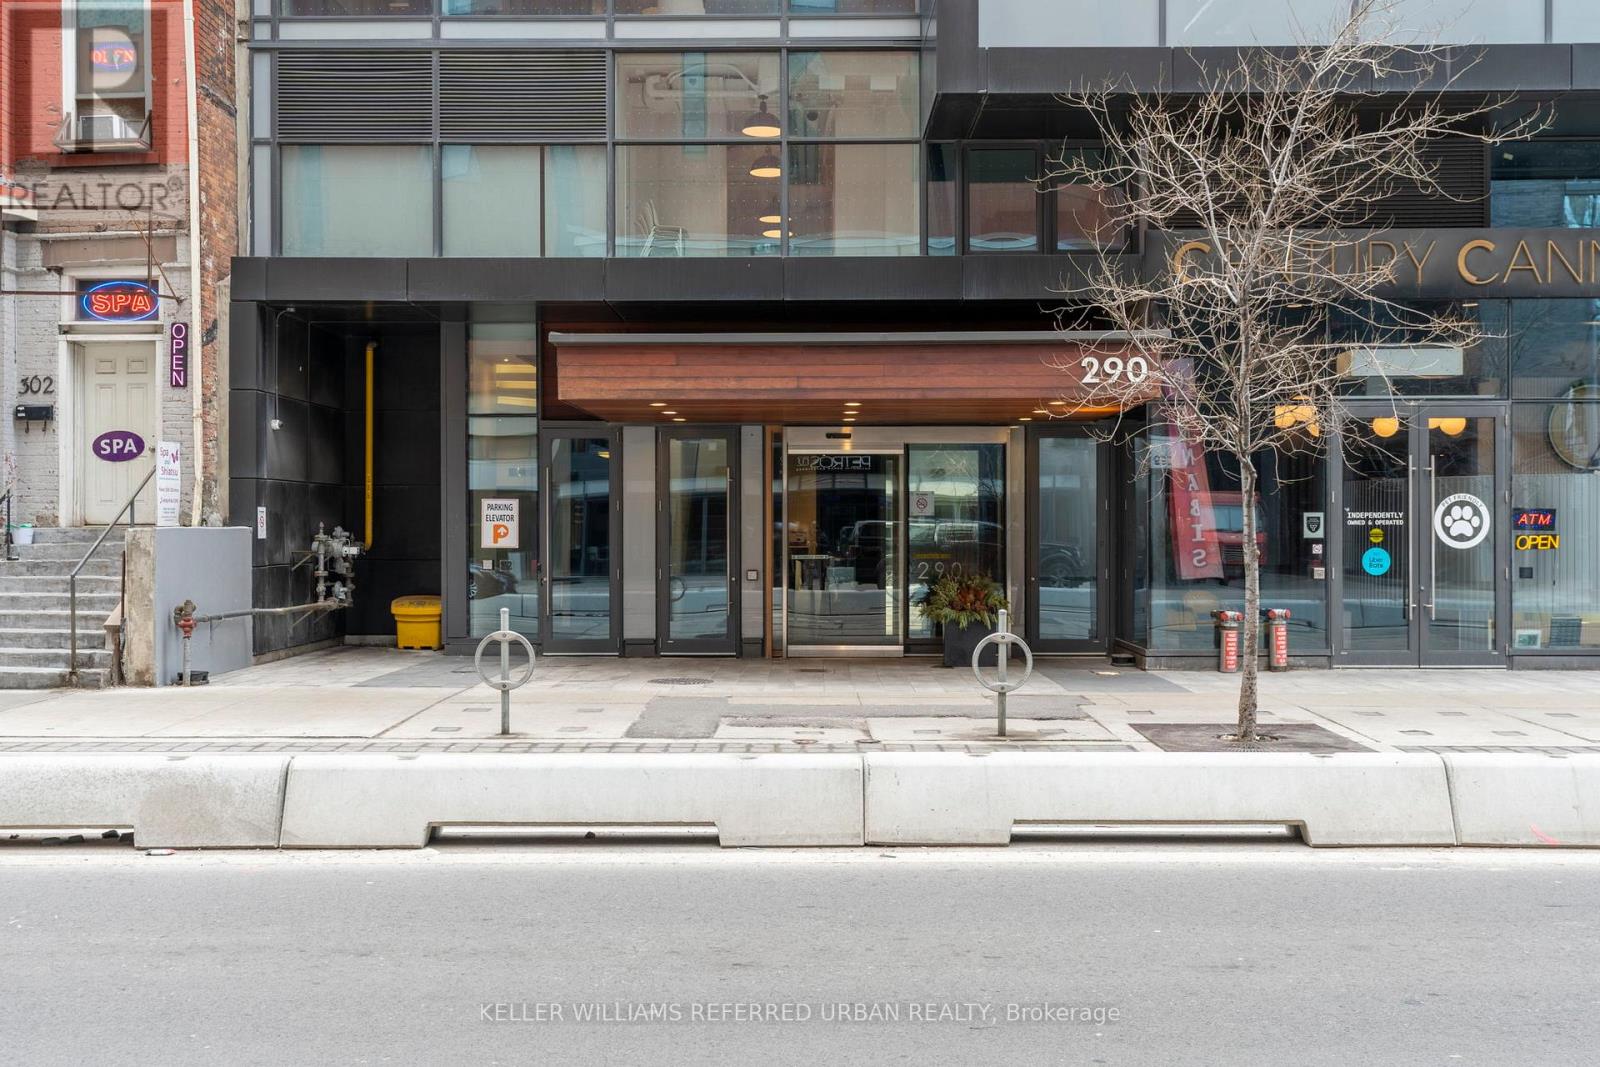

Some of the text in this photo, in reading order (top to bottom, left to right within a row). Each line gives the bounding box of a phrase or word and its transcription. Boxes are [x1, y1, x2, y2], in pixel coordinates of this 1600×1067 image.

[1457, 239, 1600, 285] CAN
[91, 294, 151, 313] SPA
[172, 323, 186, 386] OPEN
[1081, 357, 1148, 384] 290
[18, 374, 55, 394] 302
[100, 438, 137, 454] SPA
[486, 503, 513, 512] PARKING
[485, 514, 514, 522] ELEVATOR
[1518, 513, 1552, 525] ATM
[1516, 535, 1560, 550] OPEN
[918, 561, 962, 579] 290
